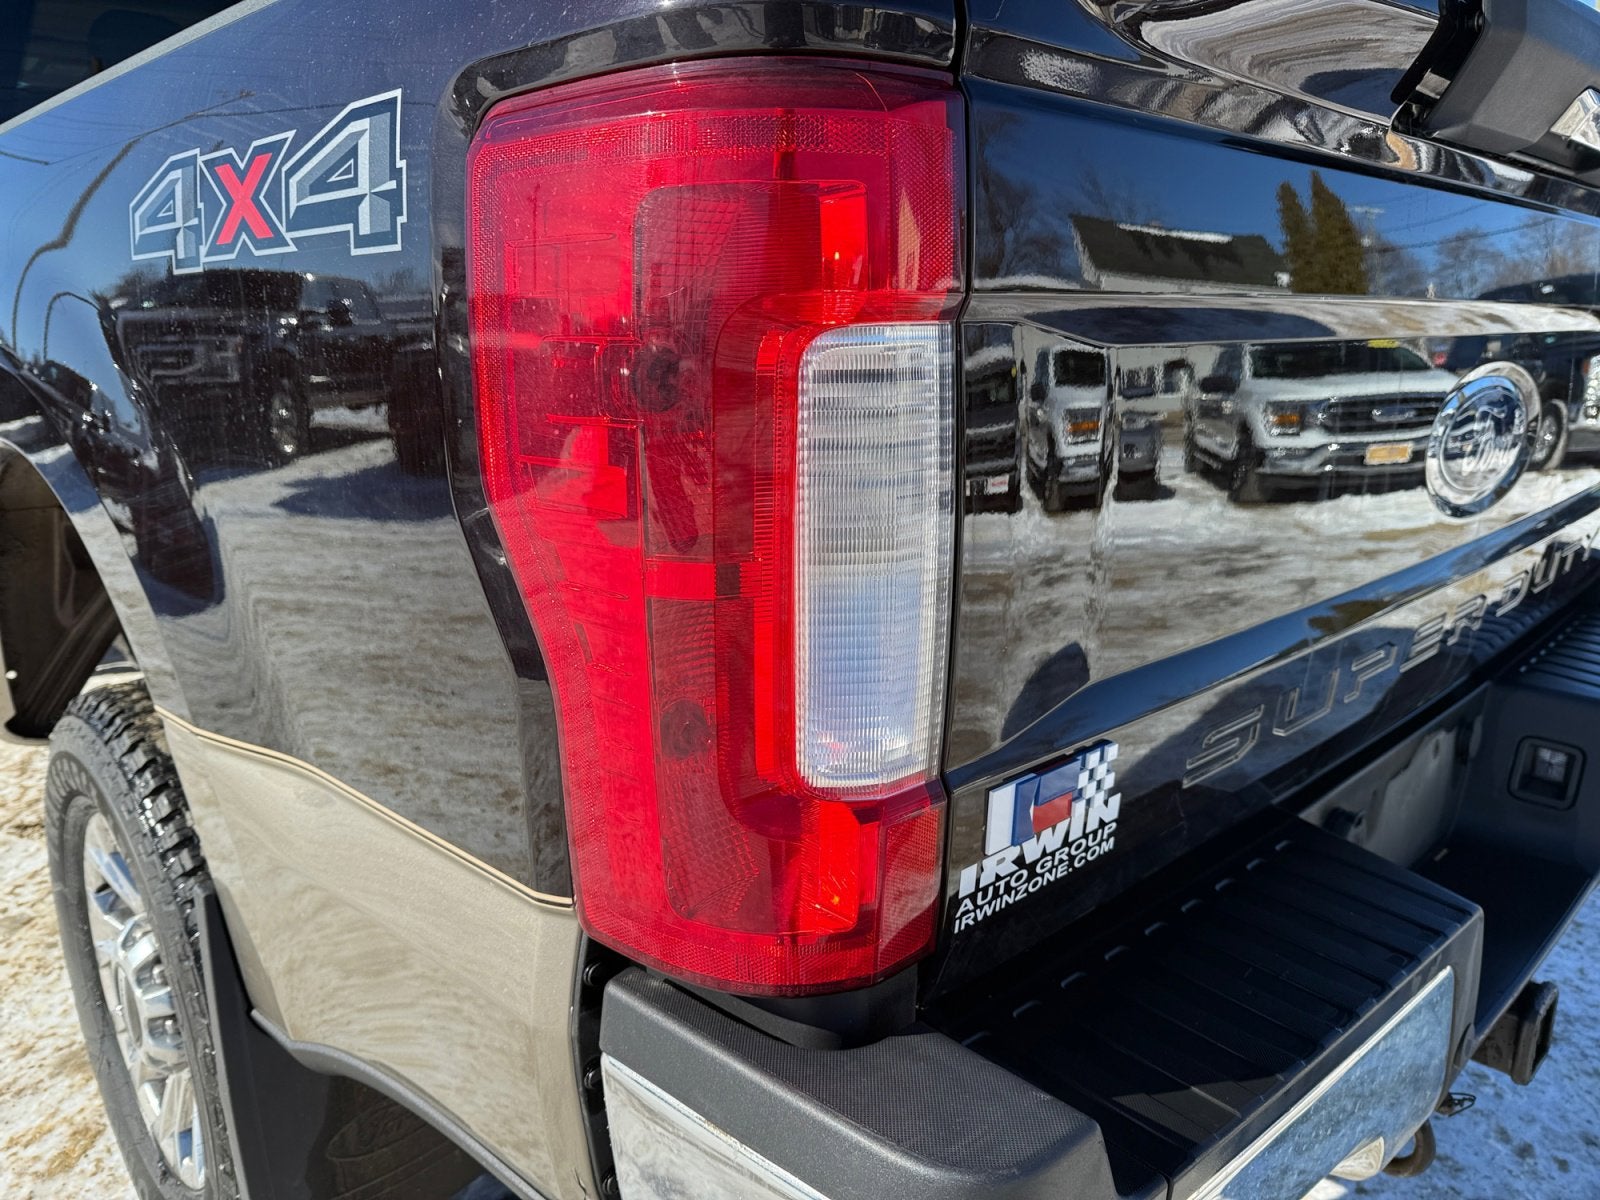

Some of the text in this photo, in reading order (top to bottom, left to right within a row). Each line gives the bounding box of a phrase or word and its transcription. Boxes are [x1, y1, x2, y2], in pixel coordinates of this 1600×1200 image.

[1461, 404, 1522, 476] Ford
[1182, 594, 1487, 789] SUPER
[954, 836, 1115, 934] IRWINZONE.COM
[955, 822, 1117, 918] AUTO GROUP
[958, 792, 1121, 899] IRWIN
